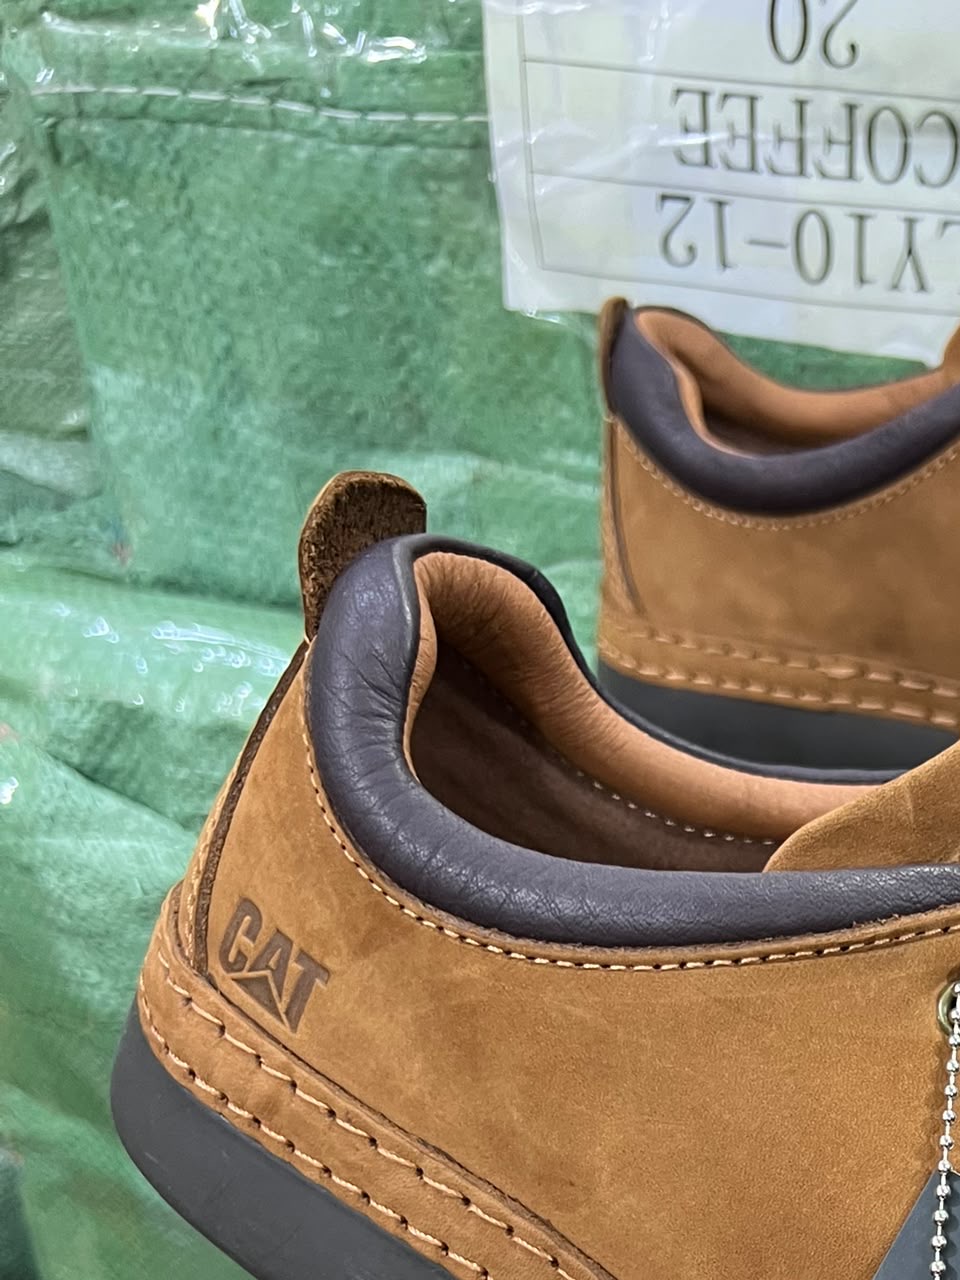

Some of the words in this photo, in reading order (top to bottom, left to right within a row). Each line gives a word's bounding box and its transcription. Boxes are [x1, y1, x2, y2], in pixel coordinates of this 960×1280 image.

[768, 0, 859, 68] 20
[671, 87, 960, 188] COFFEE
[219, 895, 331, 1034] CAT
